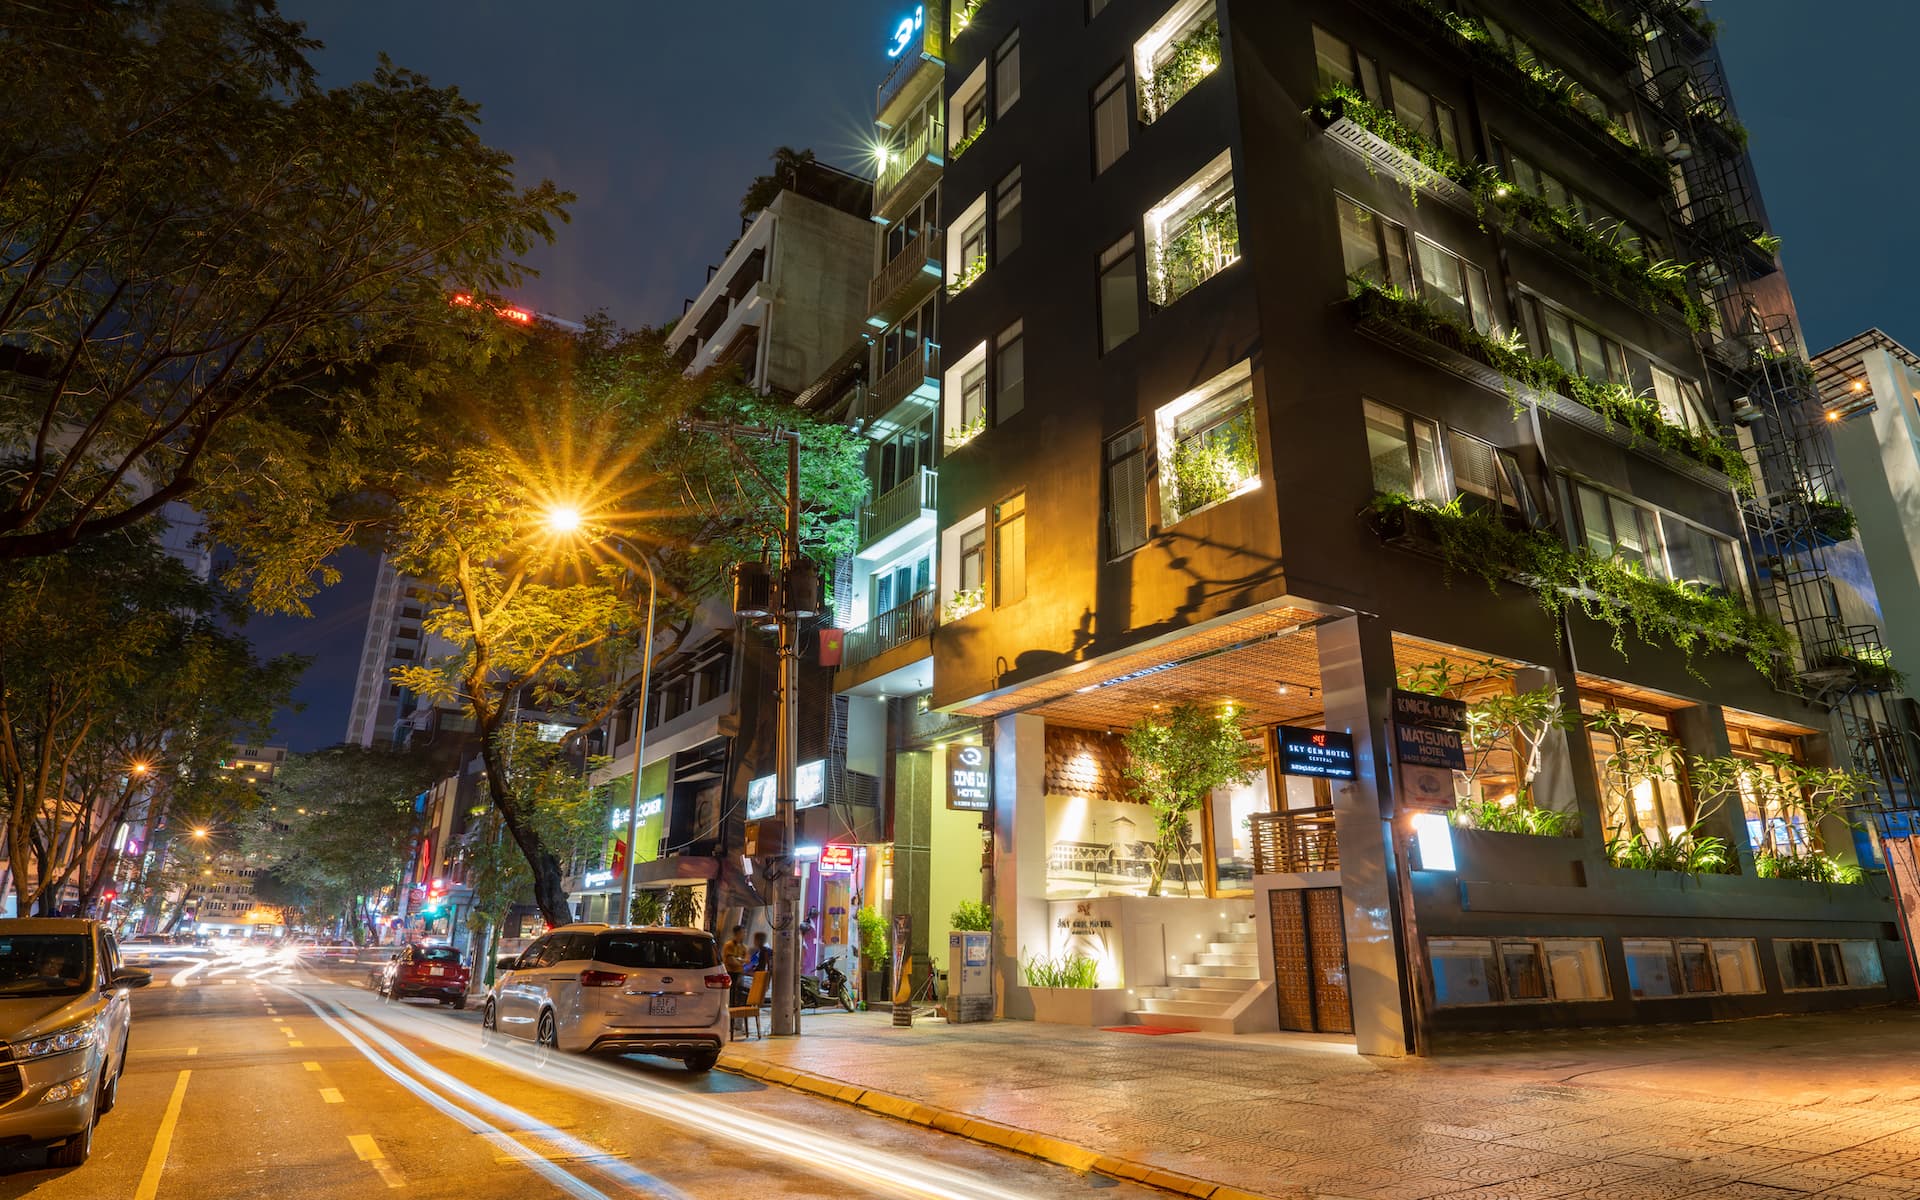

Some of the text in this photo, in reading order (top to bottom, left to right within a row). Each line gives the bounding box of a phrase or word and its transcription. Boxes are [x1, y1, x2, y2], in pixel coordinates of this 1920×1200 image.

[1397, 697, 1431, 715] KNICK
[1401, 727, 1459, 749] MATSUNOI
[1289, 744, 1305, 753] SKY
[1326, 749, 1350, 759] HOTEL
[1419, 745, 1446, 757] HOTEL
[954, 770, 988, 788] DONG DU
[957, 788, 985, 798] HOTEL
